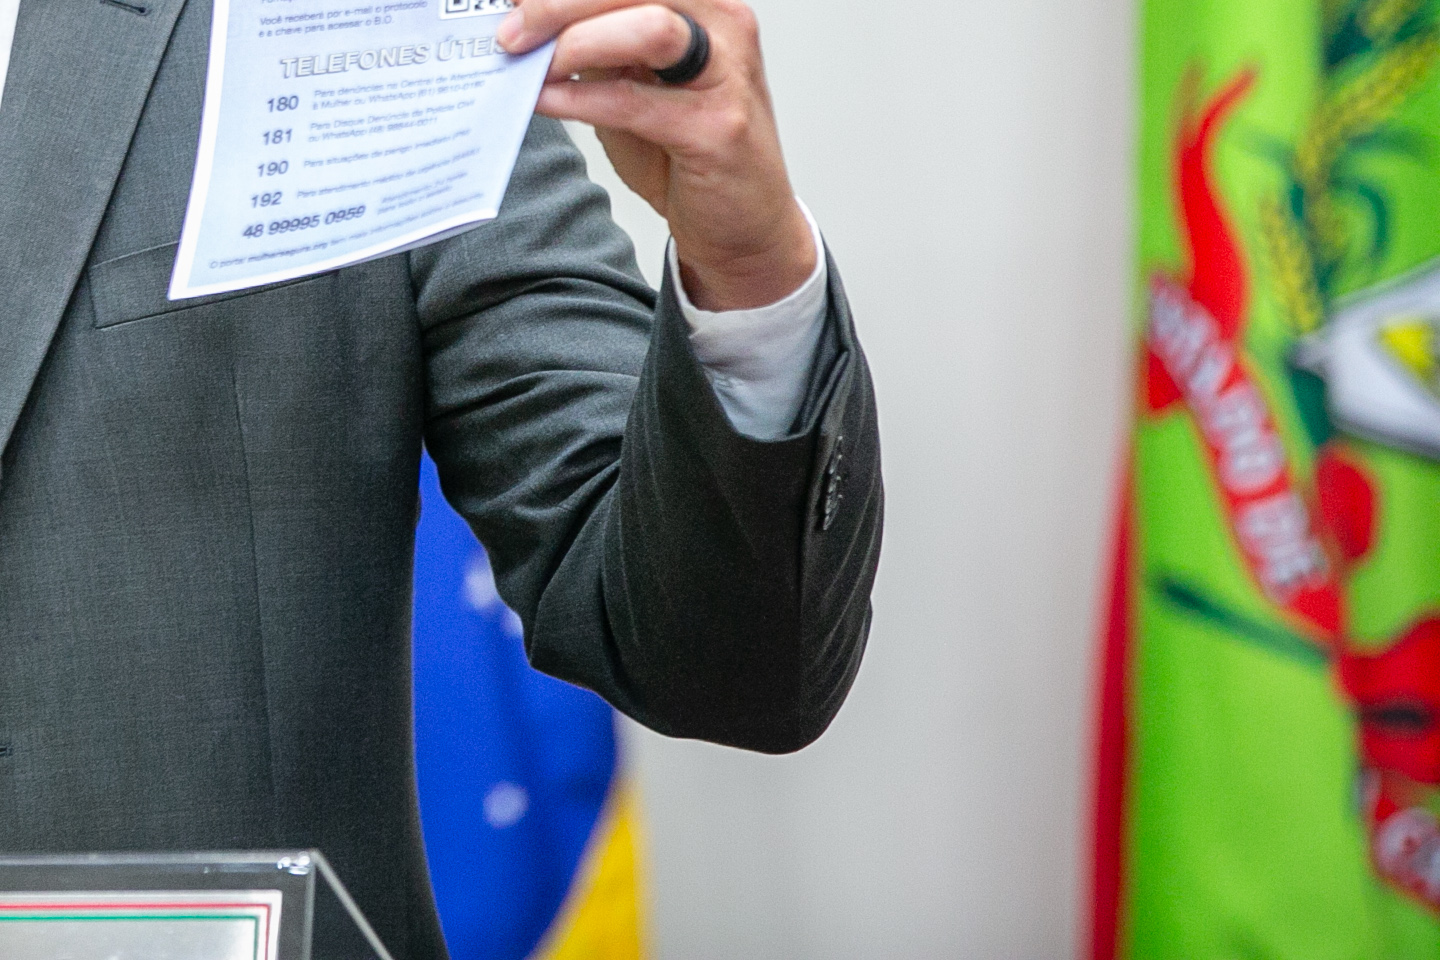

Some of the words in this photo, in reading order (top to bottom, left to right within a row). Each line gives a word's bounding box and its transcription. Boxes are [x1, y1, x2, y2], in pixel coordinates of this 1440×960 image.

[259, 15, 283, 26] Você
[284, 10, 325, 23] receberá
[326, 9, 342, 20] por
[344, 5, 373, 17] e-mail
[375, 5, 382, 14] o
[383, 0, 429, 13] protocolo
[258, 30, 265, 38] e
[266, 29, 273, 38] a
[274, 25, 302, 37] chave
[304, 23, 325, 34] para
[327, 19, 363, 31] acessar
[364, 18, 373, 27] o
[280, 43, 431, 79] TELEFONES
[266, 95, 300, 113] 180
[314, 88, 336, 99] Para
[400, 77, 434, 89] Central
[321, 98, 352, 110] Mulher
[368, 90, 416, 104] WhatsApp
[261, 128, 294, 146] 181
[310, 121, 332, 131] Para
[333, 116, 365, 130] Disque
[257, 160, 290, 178] 190
[251, 191, 283, 209] 192
[242, 223, 264, 239] 48
[267, 214, 320, 236] 99995
[323, 204, 366, 225] 0959
